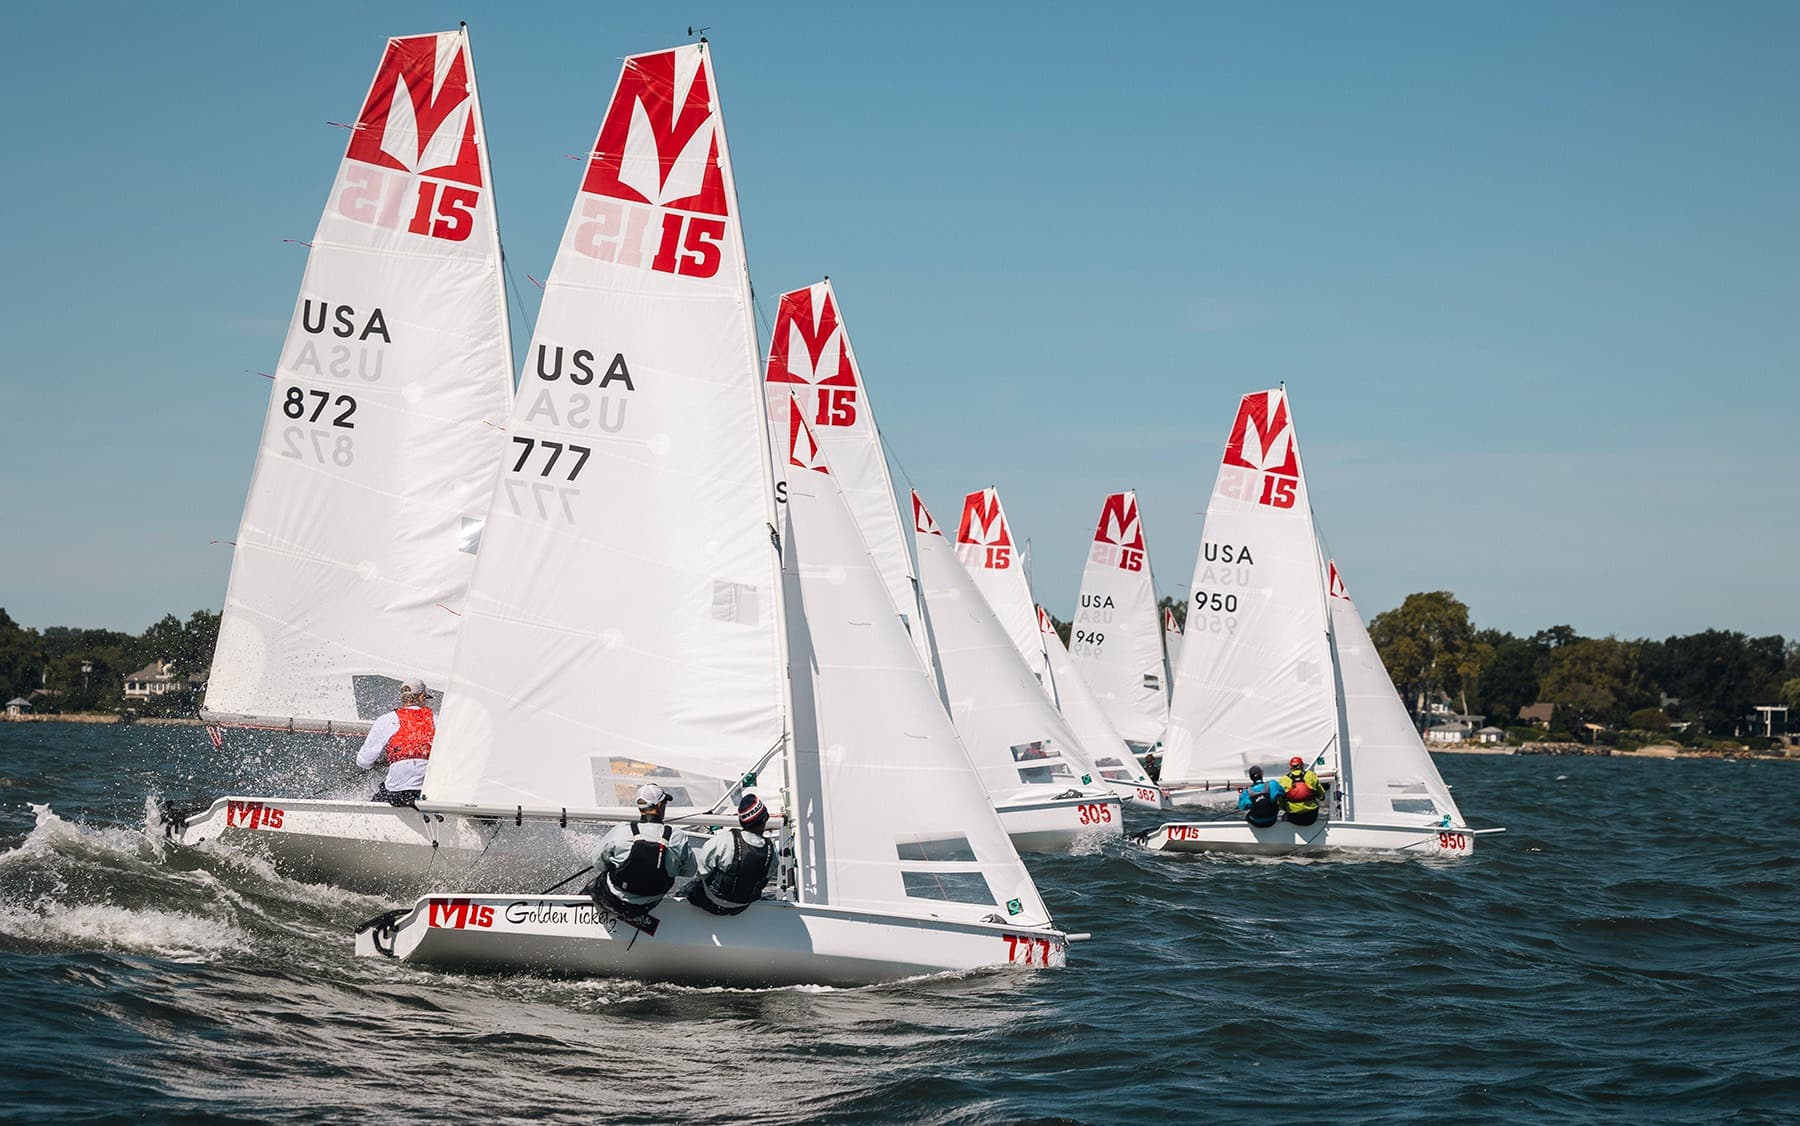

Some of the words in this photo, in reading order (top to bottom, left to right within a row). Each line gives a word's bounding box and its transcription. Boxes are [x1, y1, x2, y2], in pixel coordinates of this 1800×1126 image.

[408, 181, 480, 242] 15
[651, 213, 726, 279] 15
[302, 298, 392, 344] USA
[536, 344, 635, 391] USA
[282, 386, 357, 429] 872
[815, 388, 857, 428] 15
[512, 436, 591, 481] 777
[1259, 474, 1298, 509] 15
[984, 547, 1011, 570] 15
[1119, 549, 1145, 572] 15
[1204, 543, 1254, 565] USA
[1081, 595, 1115, 609] USA
[1195, 591, 1238, 613] 950
[1076, 630, 1105, 646] 949
[1136, 788, 1156, 802] 362
[1077, 803, 1112, 825] 305
[1439, 832, 1466, 850] 950
[505, 900, 568, 925] Golden
[1002, 933, 1051, 968] 777
